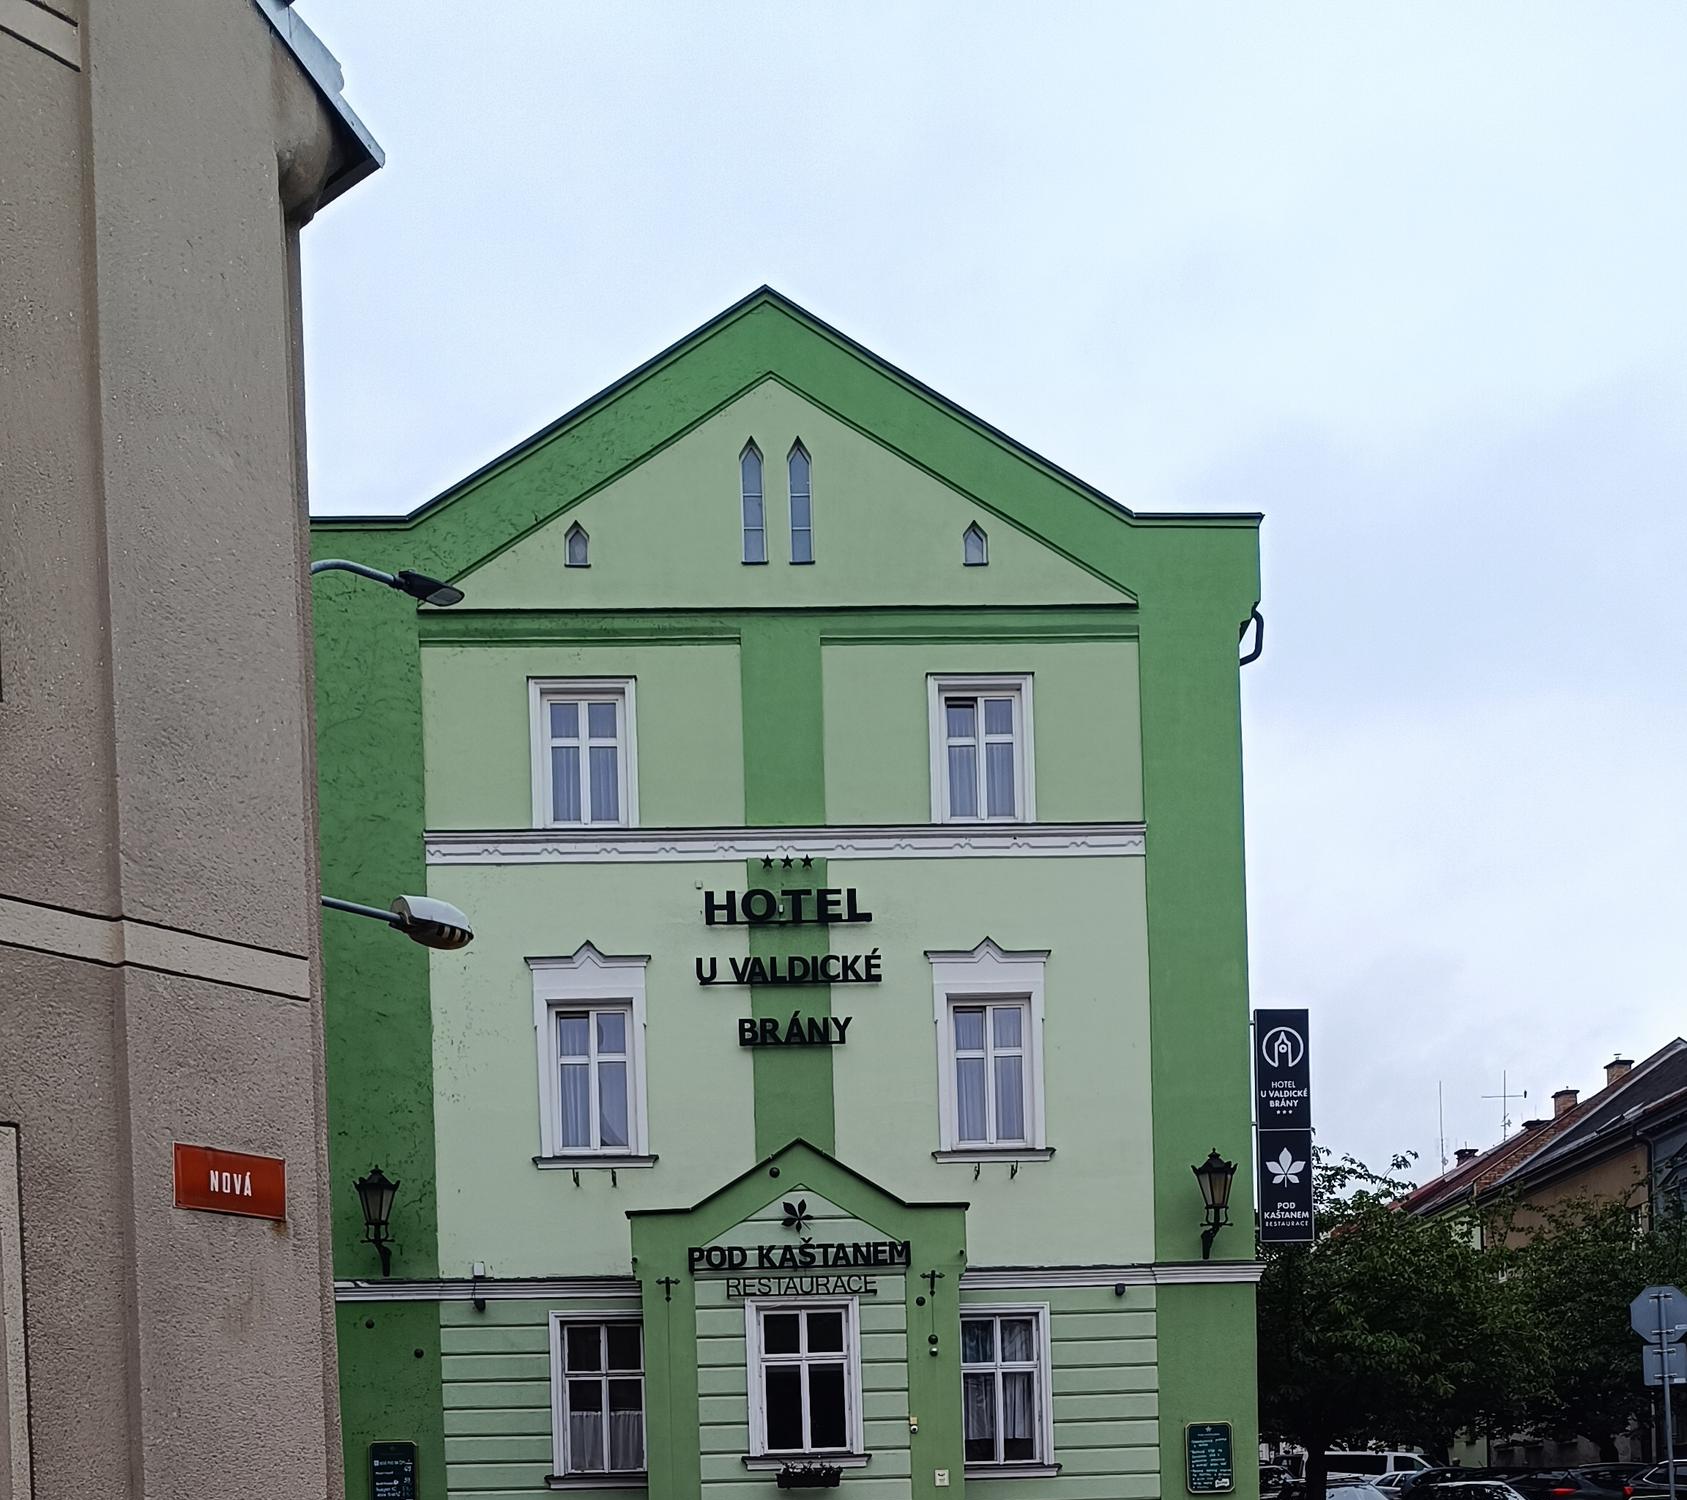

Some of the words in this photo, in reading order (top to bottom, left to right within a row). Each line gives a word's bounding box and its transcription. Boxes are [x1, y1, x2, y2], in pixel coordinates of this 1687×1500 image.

[704, 888, 873, 925] HOTEL
[695, 957, 717, 984] U
[729, 948, 882, 984] VALDICKÉ
[738, 1011, 853, 1046] BRÁNY
[1260, 1090, 1267, 1098] U
[1268, 1087, 1308, 1098] VALDICKÉ
[1271, 1080, 1296, 1089] HOTEL
[1269, 1097, 1299, 1108] BRÁNY
[209, 1169, 252, 1197] NOVÁ
[1264, 1209, 1310, 1219] KAŠTANEM
[1277, 1201, 1296, 1210] POD
[688, 1246, 748, 1271] POD
[757, 1236, 911, 1268] KAŠTANEM
[726, 1274, 878, 1298] RESTAURACE
